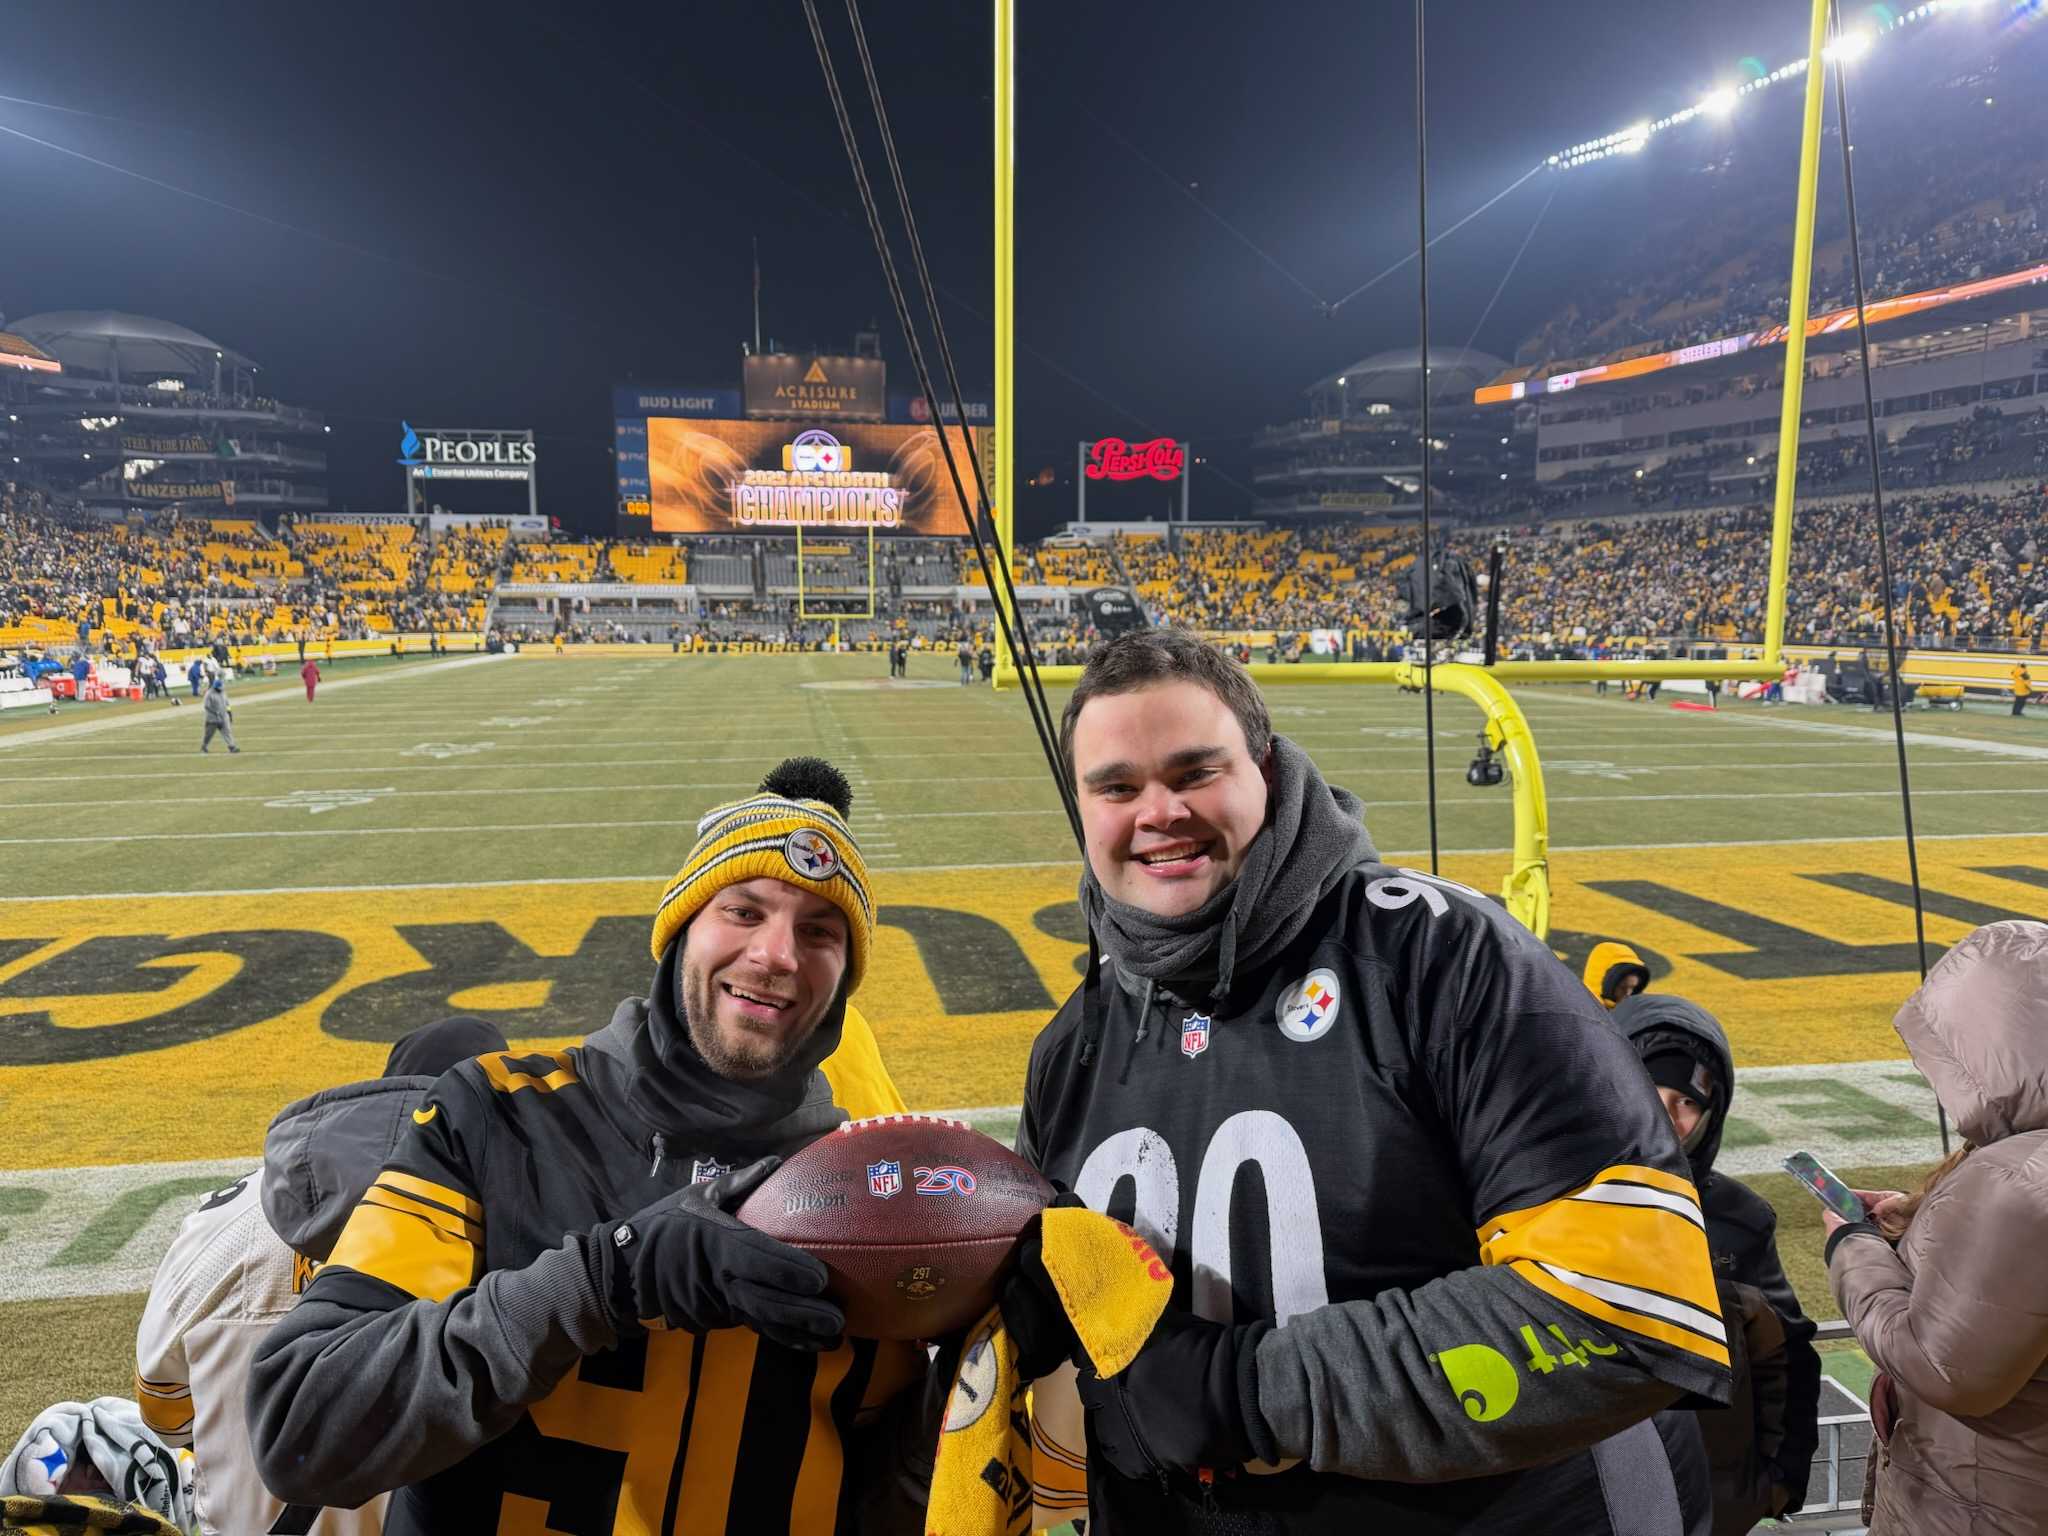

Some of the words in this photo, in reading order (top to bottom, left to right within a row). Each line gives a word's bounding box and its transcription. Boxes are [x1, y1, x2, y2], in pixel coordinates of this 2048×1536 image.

[775, 385, 857, 400] ACRISURE
[639, 396, 670, 409] BUD
[671, 397, 715, 411] LIGHT
[791, 399, 841, 411] STADIUM
[931, 402, 988, 418] UMBER
[424, 437, 537, 463] PEOPLES
[735, 485, 900, 528] CHAMPIONS
[1183, 1030, 1206, 1051] NFL
[871, 1174, 899, 1193] NFL
[783, 1192, 849, 1214] Wilson
